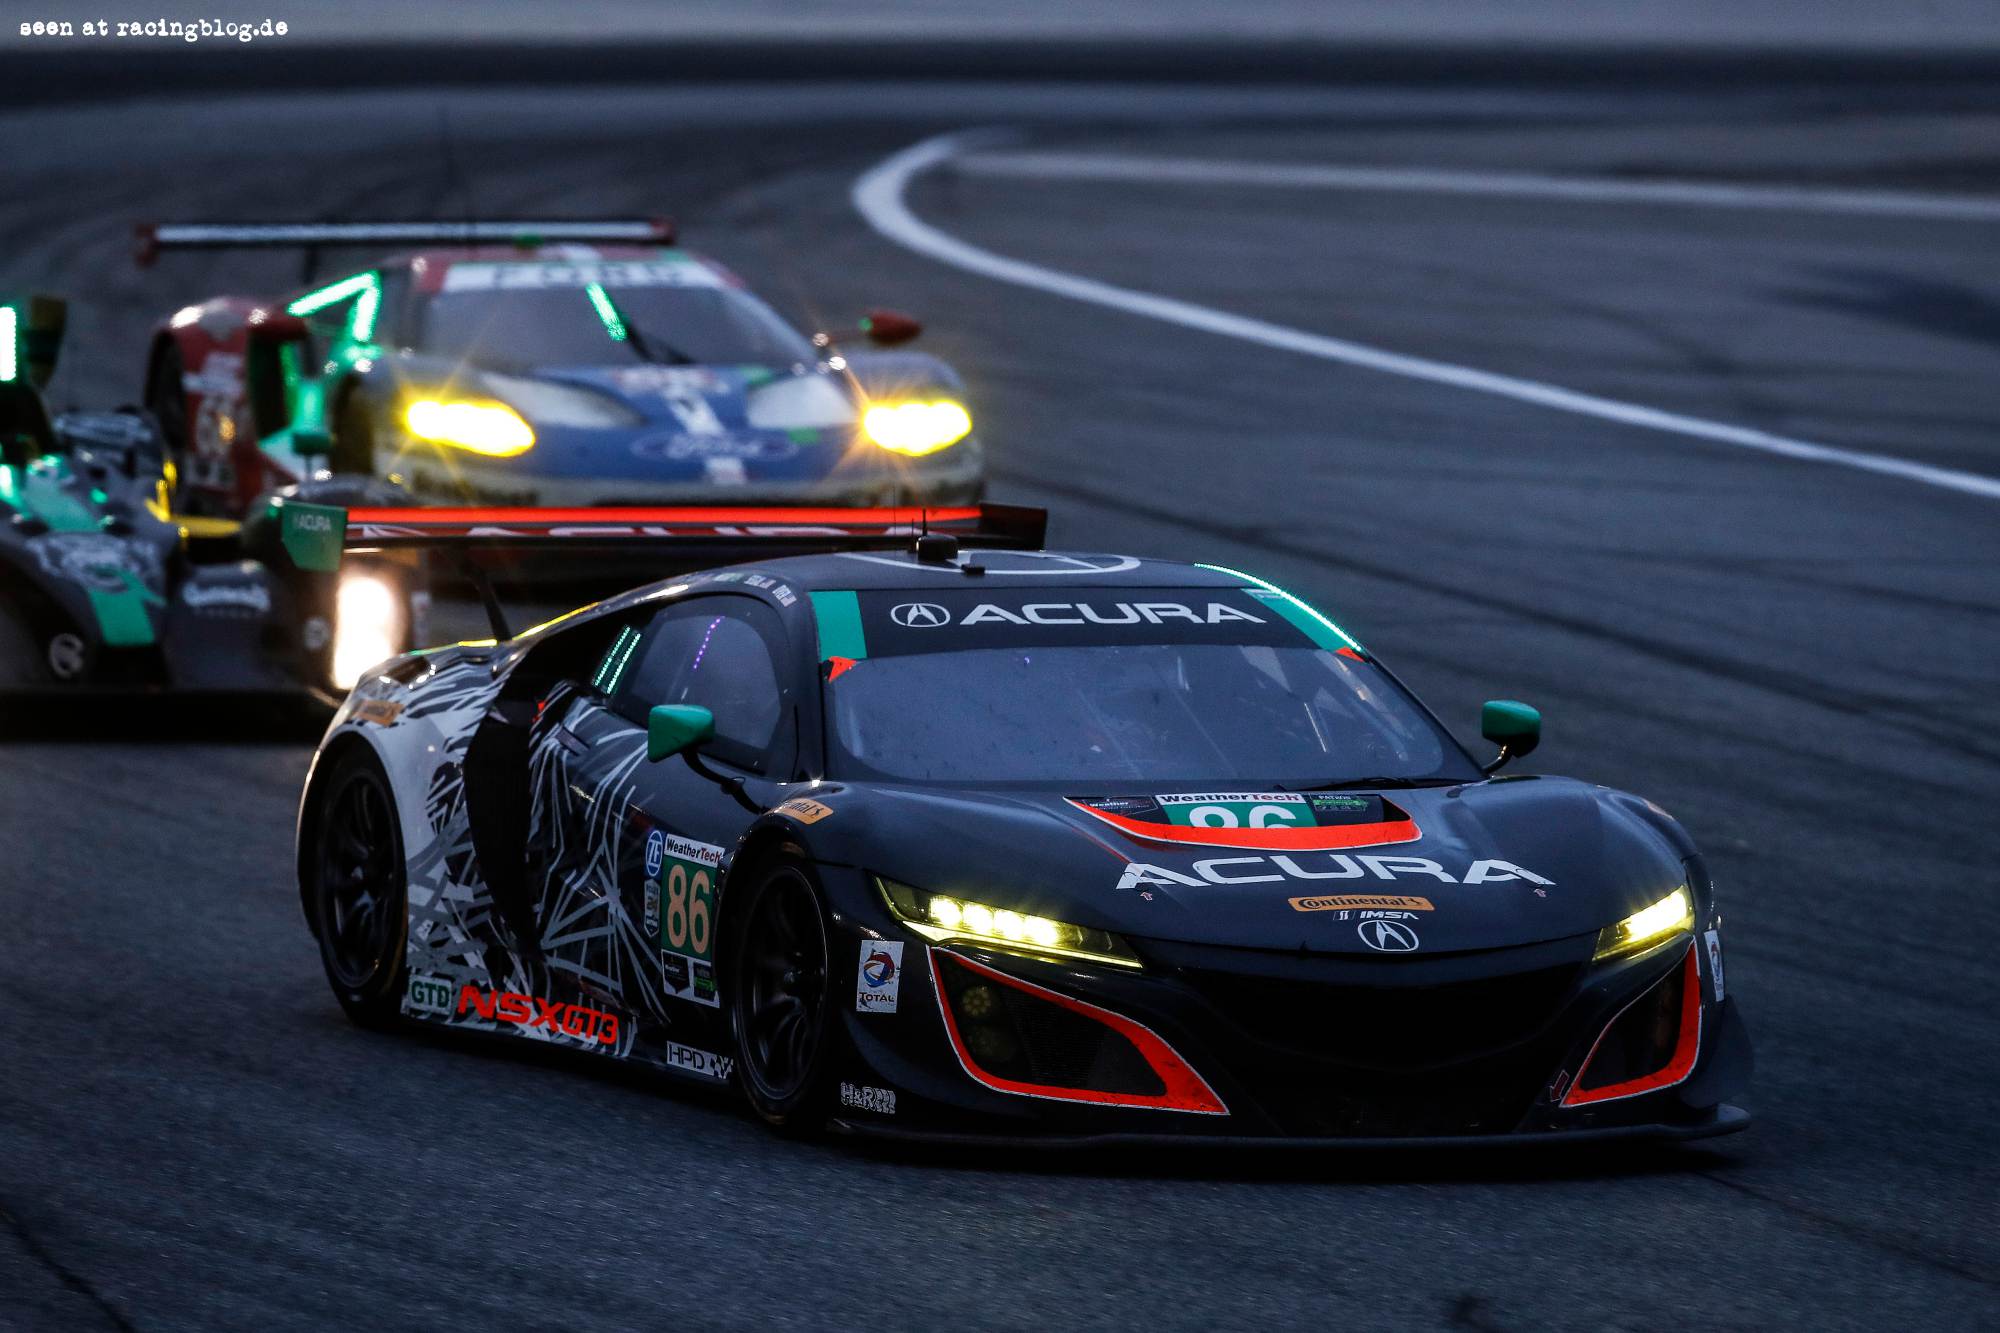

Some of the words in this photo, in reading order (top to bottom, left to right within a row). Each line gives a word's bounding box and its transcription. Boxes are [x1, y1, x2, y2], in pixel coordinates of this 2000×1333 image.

[960, 602, 1267, 626] ACURA
[1160, 793, 1300, 803] WeatherTech
[666, 838, 721, 864] WeatherTech
[1116, 854, 1557, 890] ACURA
[667, 864, 710, 954] 86
[1298, 897, 1406, 909] Continental
[411, 980, 450, 1008] GTD
[858, 991, 895, 1003] TOTAL
[668, 1043, 705, 1070] HPD
